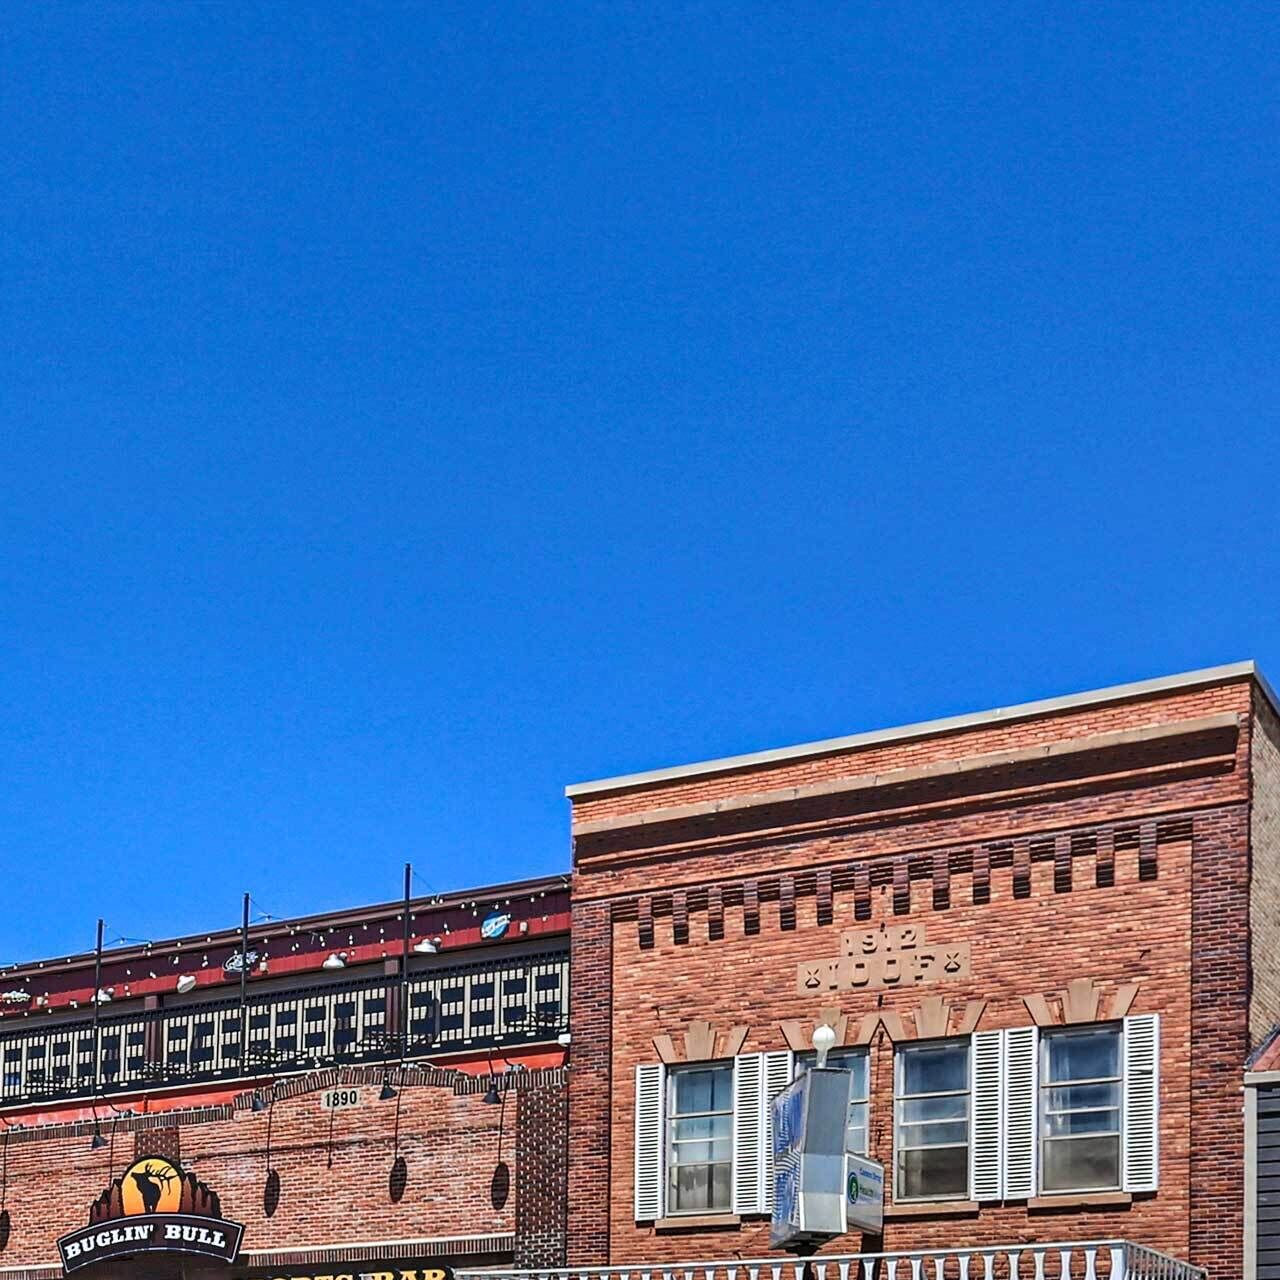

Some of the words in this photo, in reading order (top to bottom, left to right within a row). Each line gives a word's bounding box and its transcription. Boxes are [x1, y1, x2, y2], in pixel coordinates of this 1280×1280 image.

[326, 1090, 357, 1107] 1890
[64, 1224, 154, 1260] BUGLIN'
[164, 1224, 226, 1249] BULL
